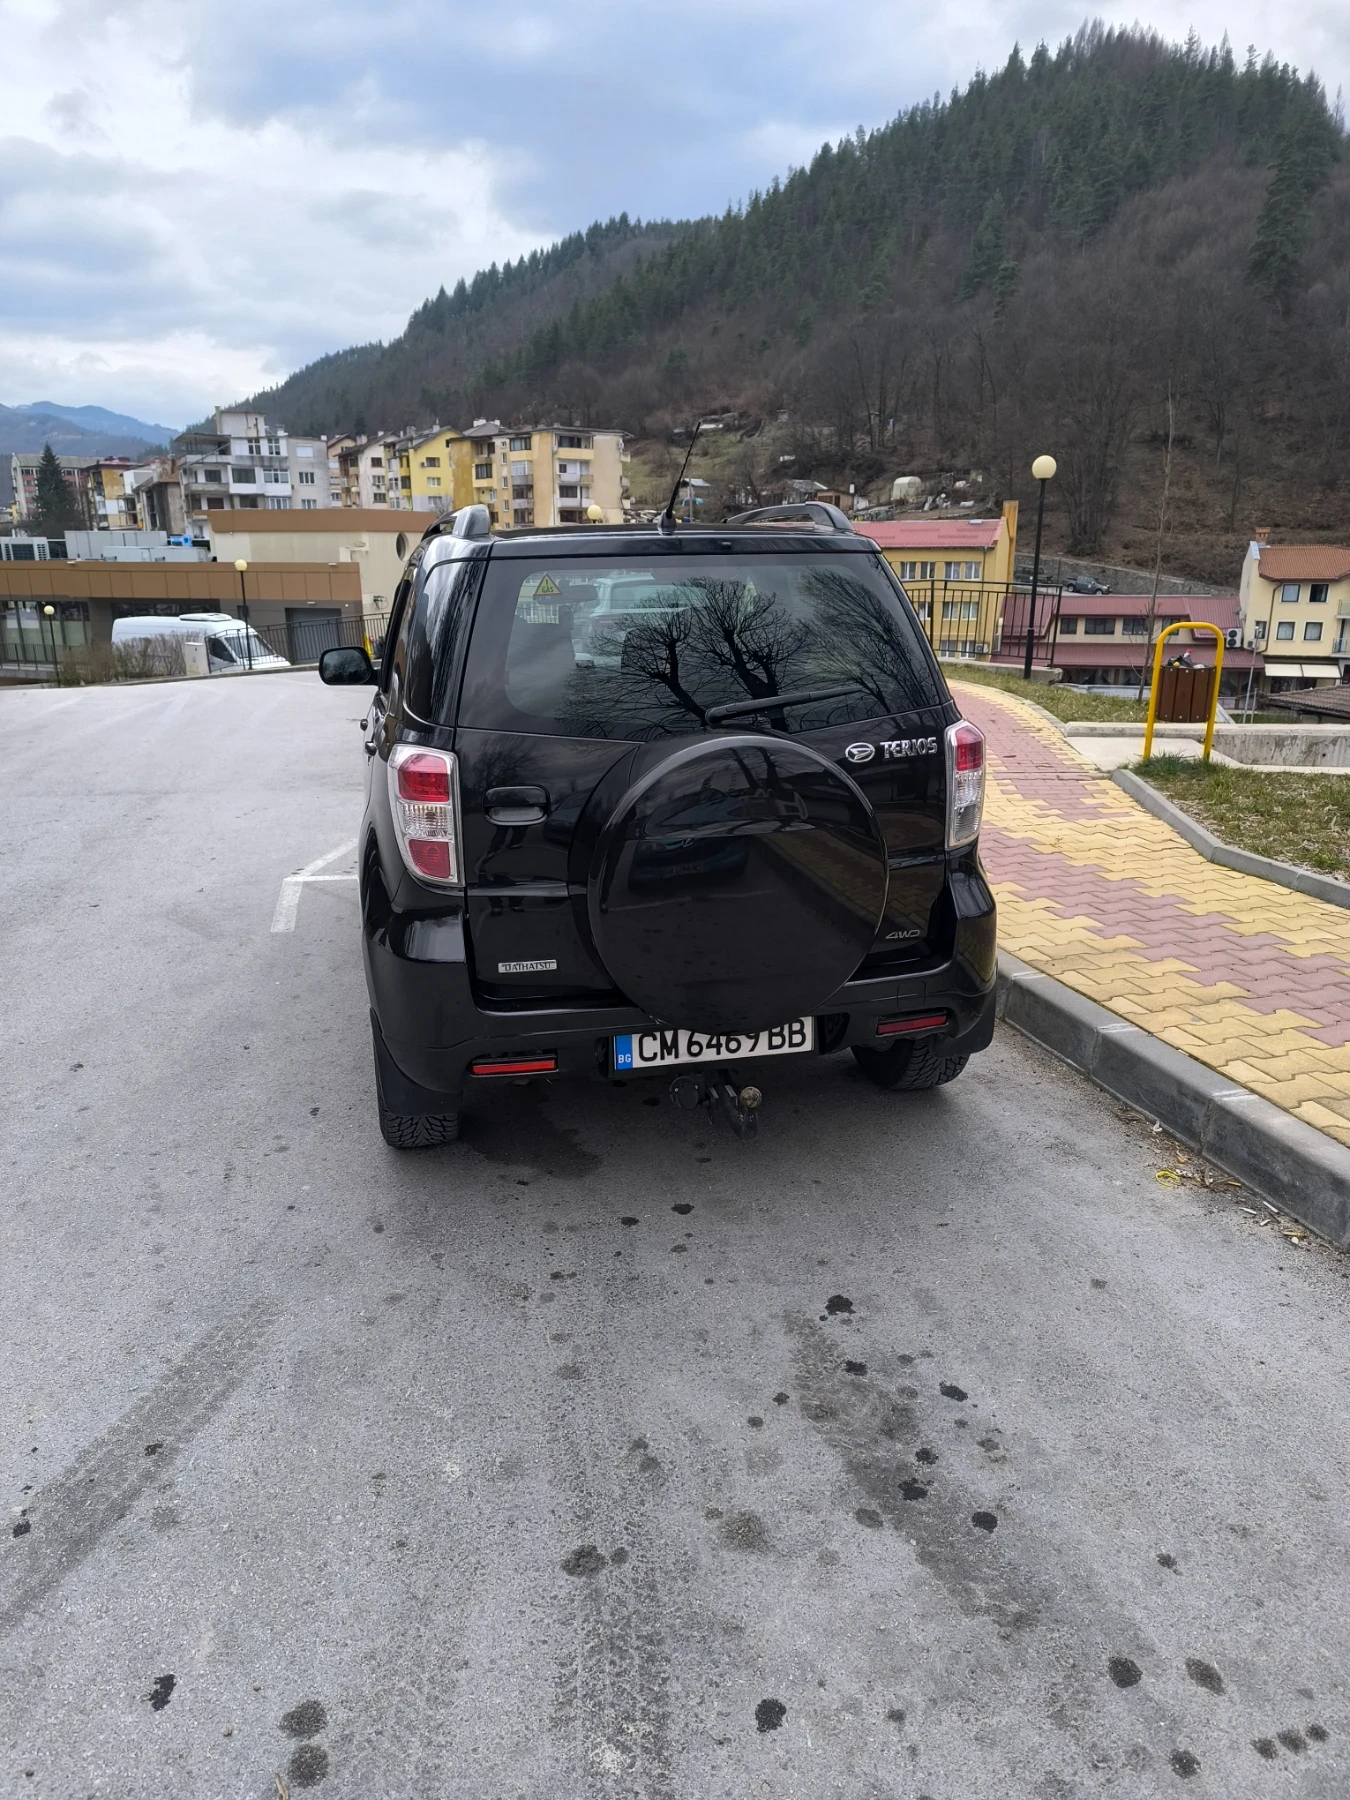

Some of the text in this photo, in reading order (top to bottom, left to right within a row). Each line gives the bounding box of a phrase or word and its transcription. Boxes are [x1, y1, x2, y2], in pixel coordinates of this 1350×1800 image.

[880, 737, 938, 758] TERIOS
[885, 930, 920, 939] 4WD
[502, 961, 551, 972] DAIHATSU
[638, 1029, 679, 1062] CM
[767, 1018, 806, 1050] BB
[618, 1054, 632, 1064] BG
